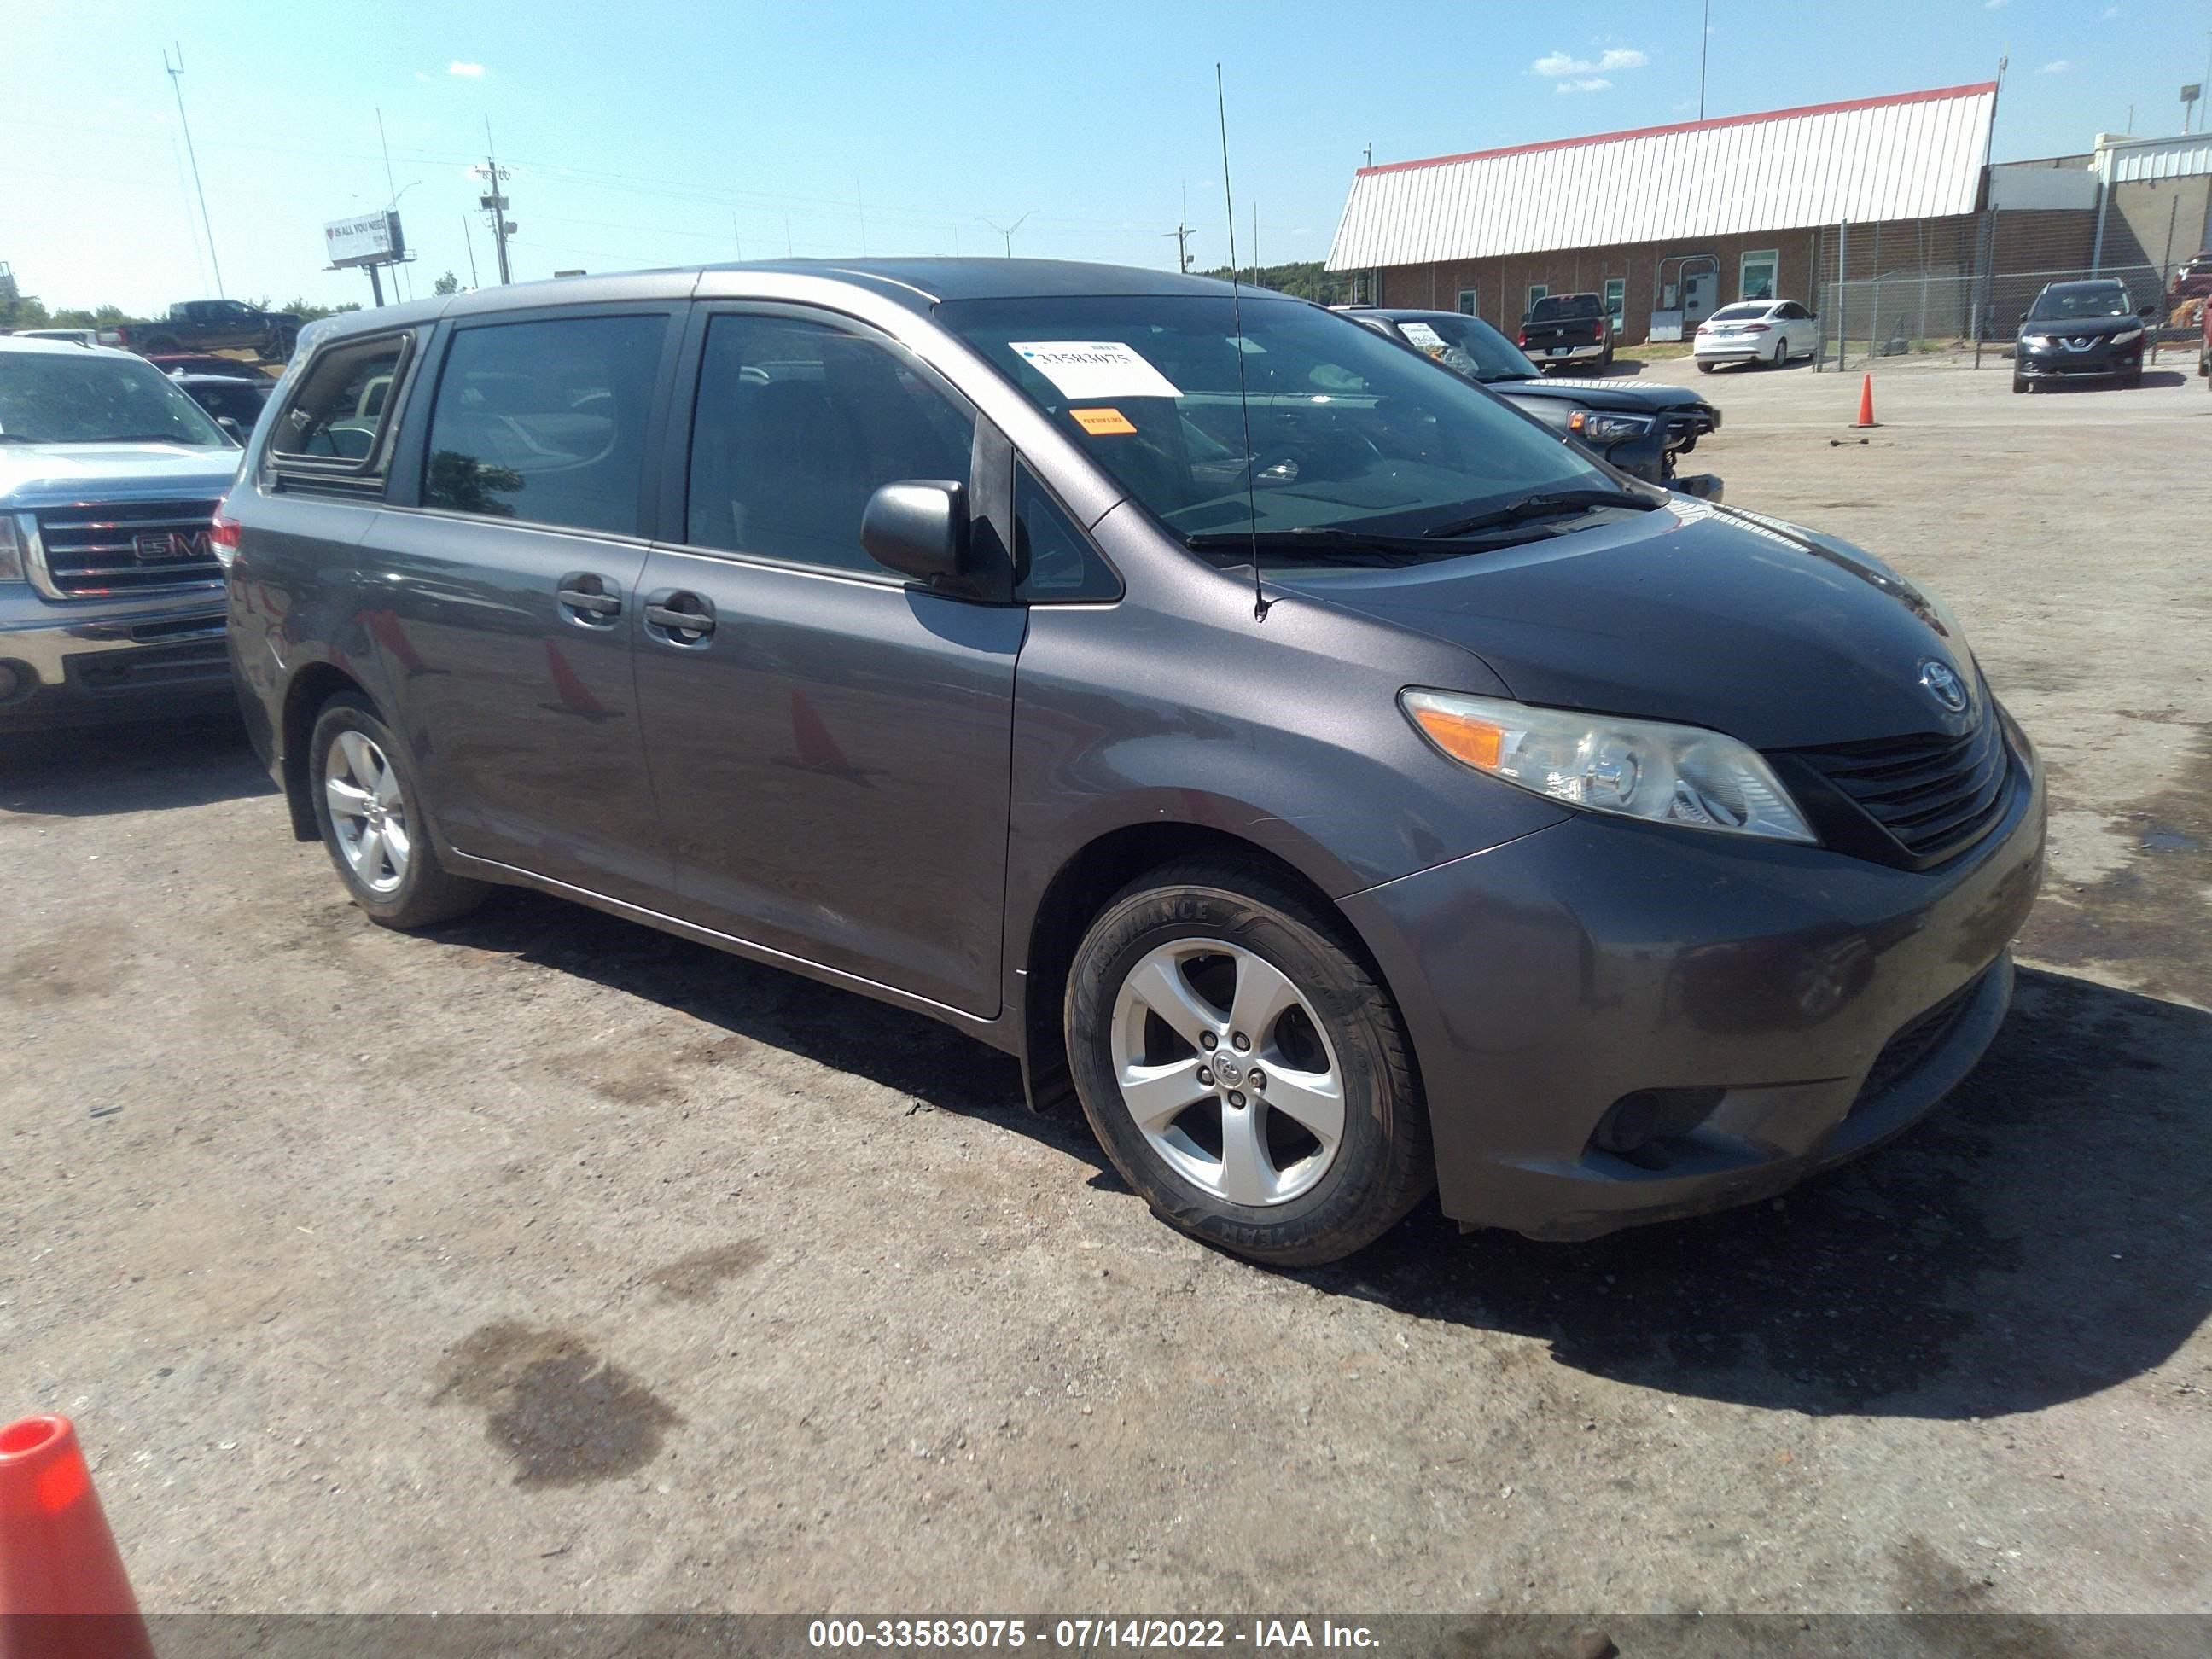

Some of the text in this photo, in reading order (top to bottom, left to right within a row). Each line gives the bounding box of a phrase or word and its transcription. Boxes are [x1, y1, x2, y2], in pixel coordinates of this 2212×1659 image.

[335, 219, 385, 237] IS ALL YOU NEED
[1036, 353, 1132, 364] 33583075
[132, 531, 212, 559] GM
[1092, 900, 1209, 982] ASSURANCE
